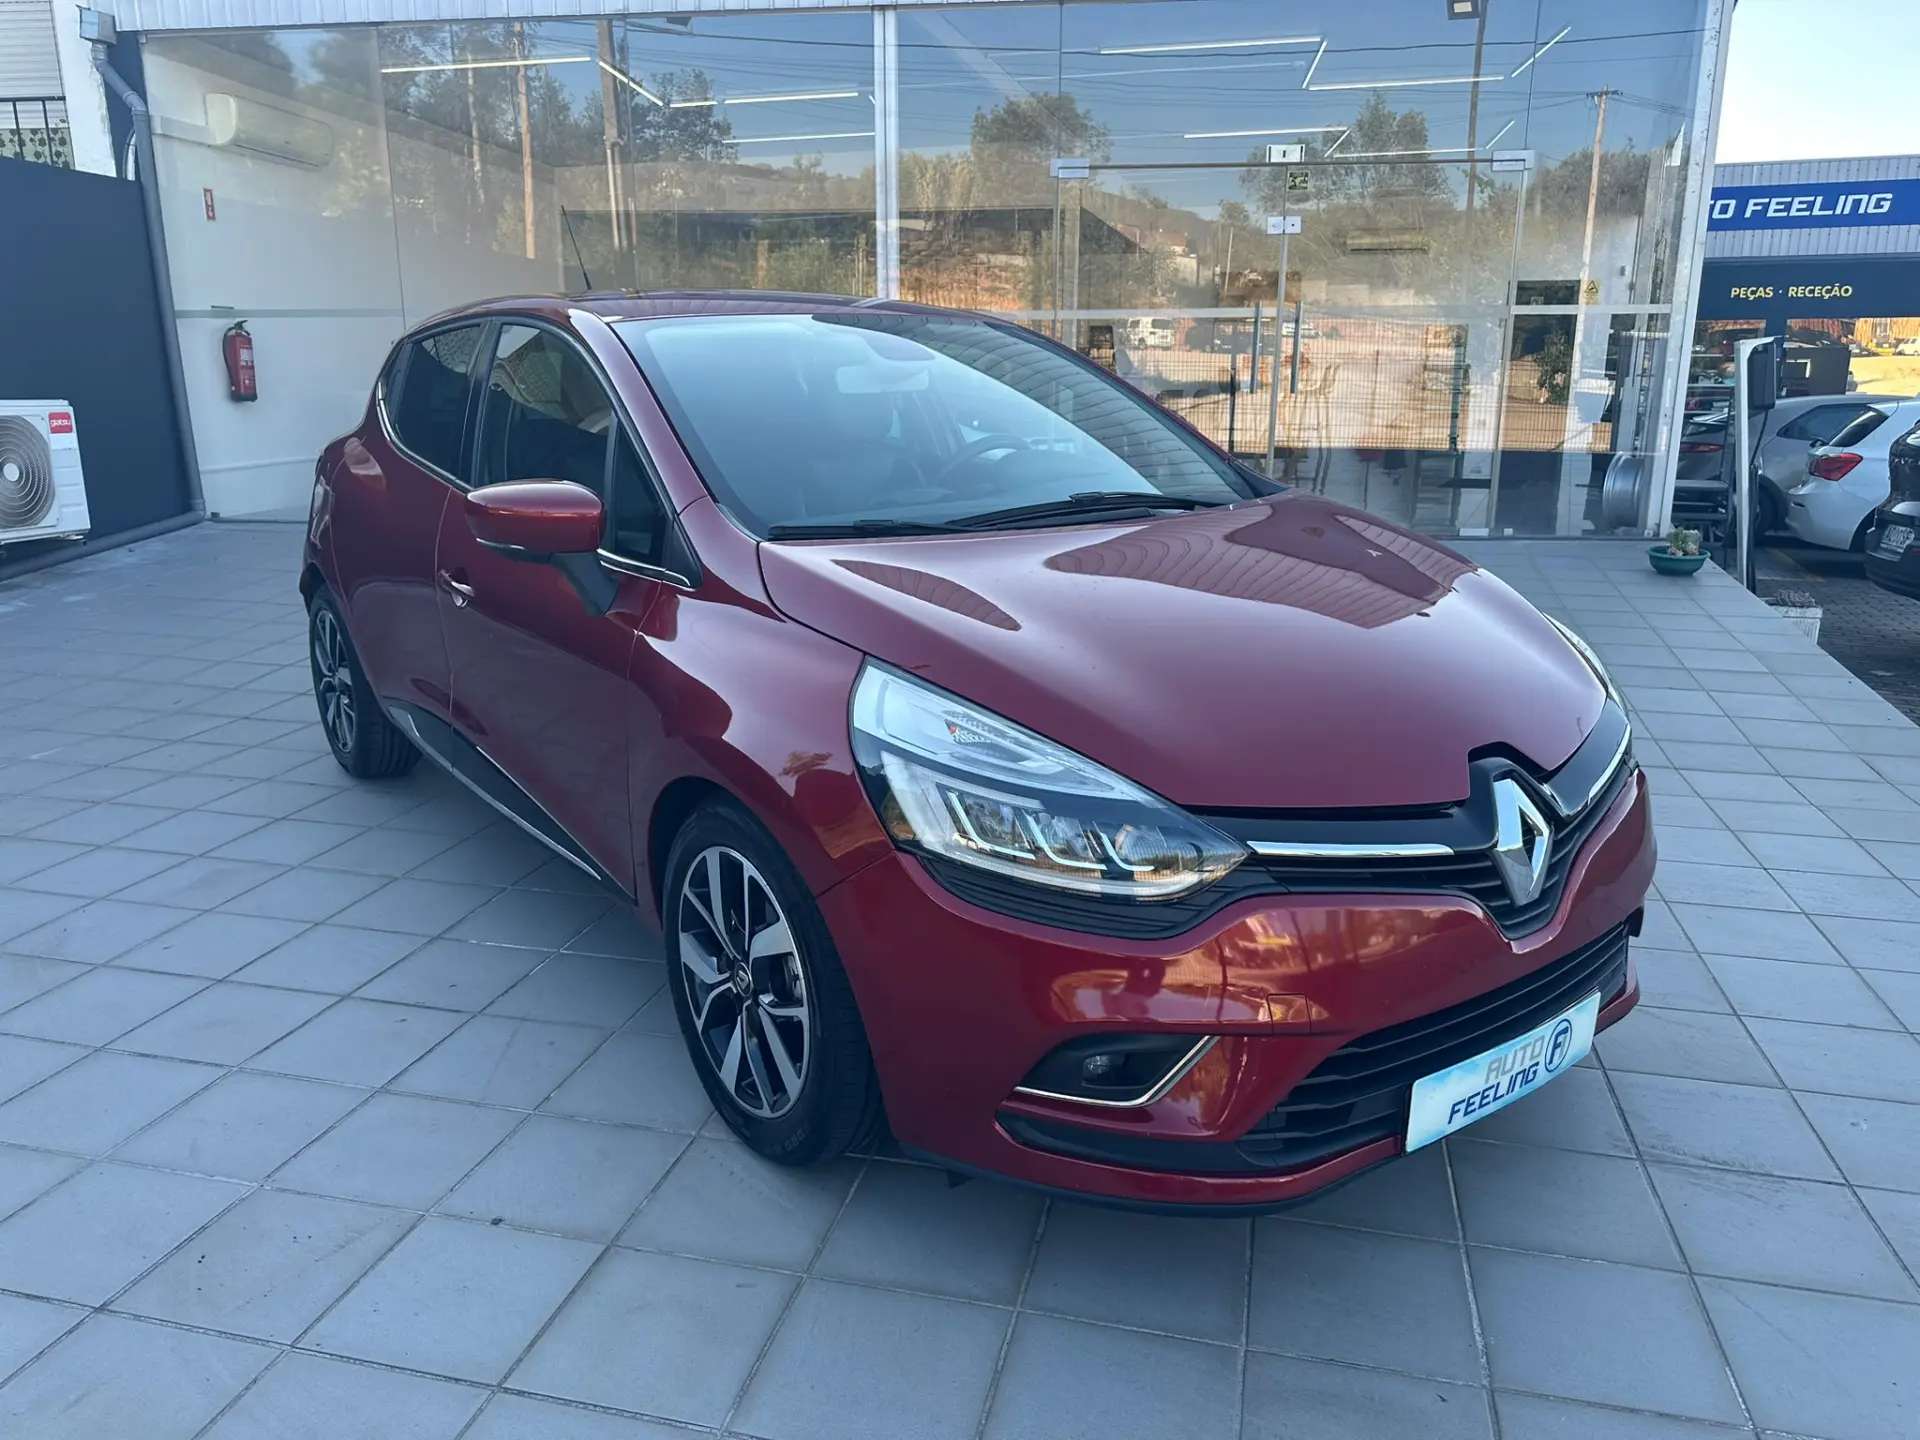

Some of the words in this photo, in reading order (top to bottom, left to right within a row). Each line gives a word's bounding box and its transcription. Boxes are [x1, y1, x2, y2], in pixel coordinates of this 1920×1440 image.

[1709, 199, 1736, 219] O
[1744, 193, 1893, 218] FEELING
[1730, 286, 1774, 300] PEÇAS
[1788, 283, 1853, 299] RECEÇÃO
[1484, 1034, 1545, 1085] AUTO
[1447, 1061, 1540, 1125] FEELING
